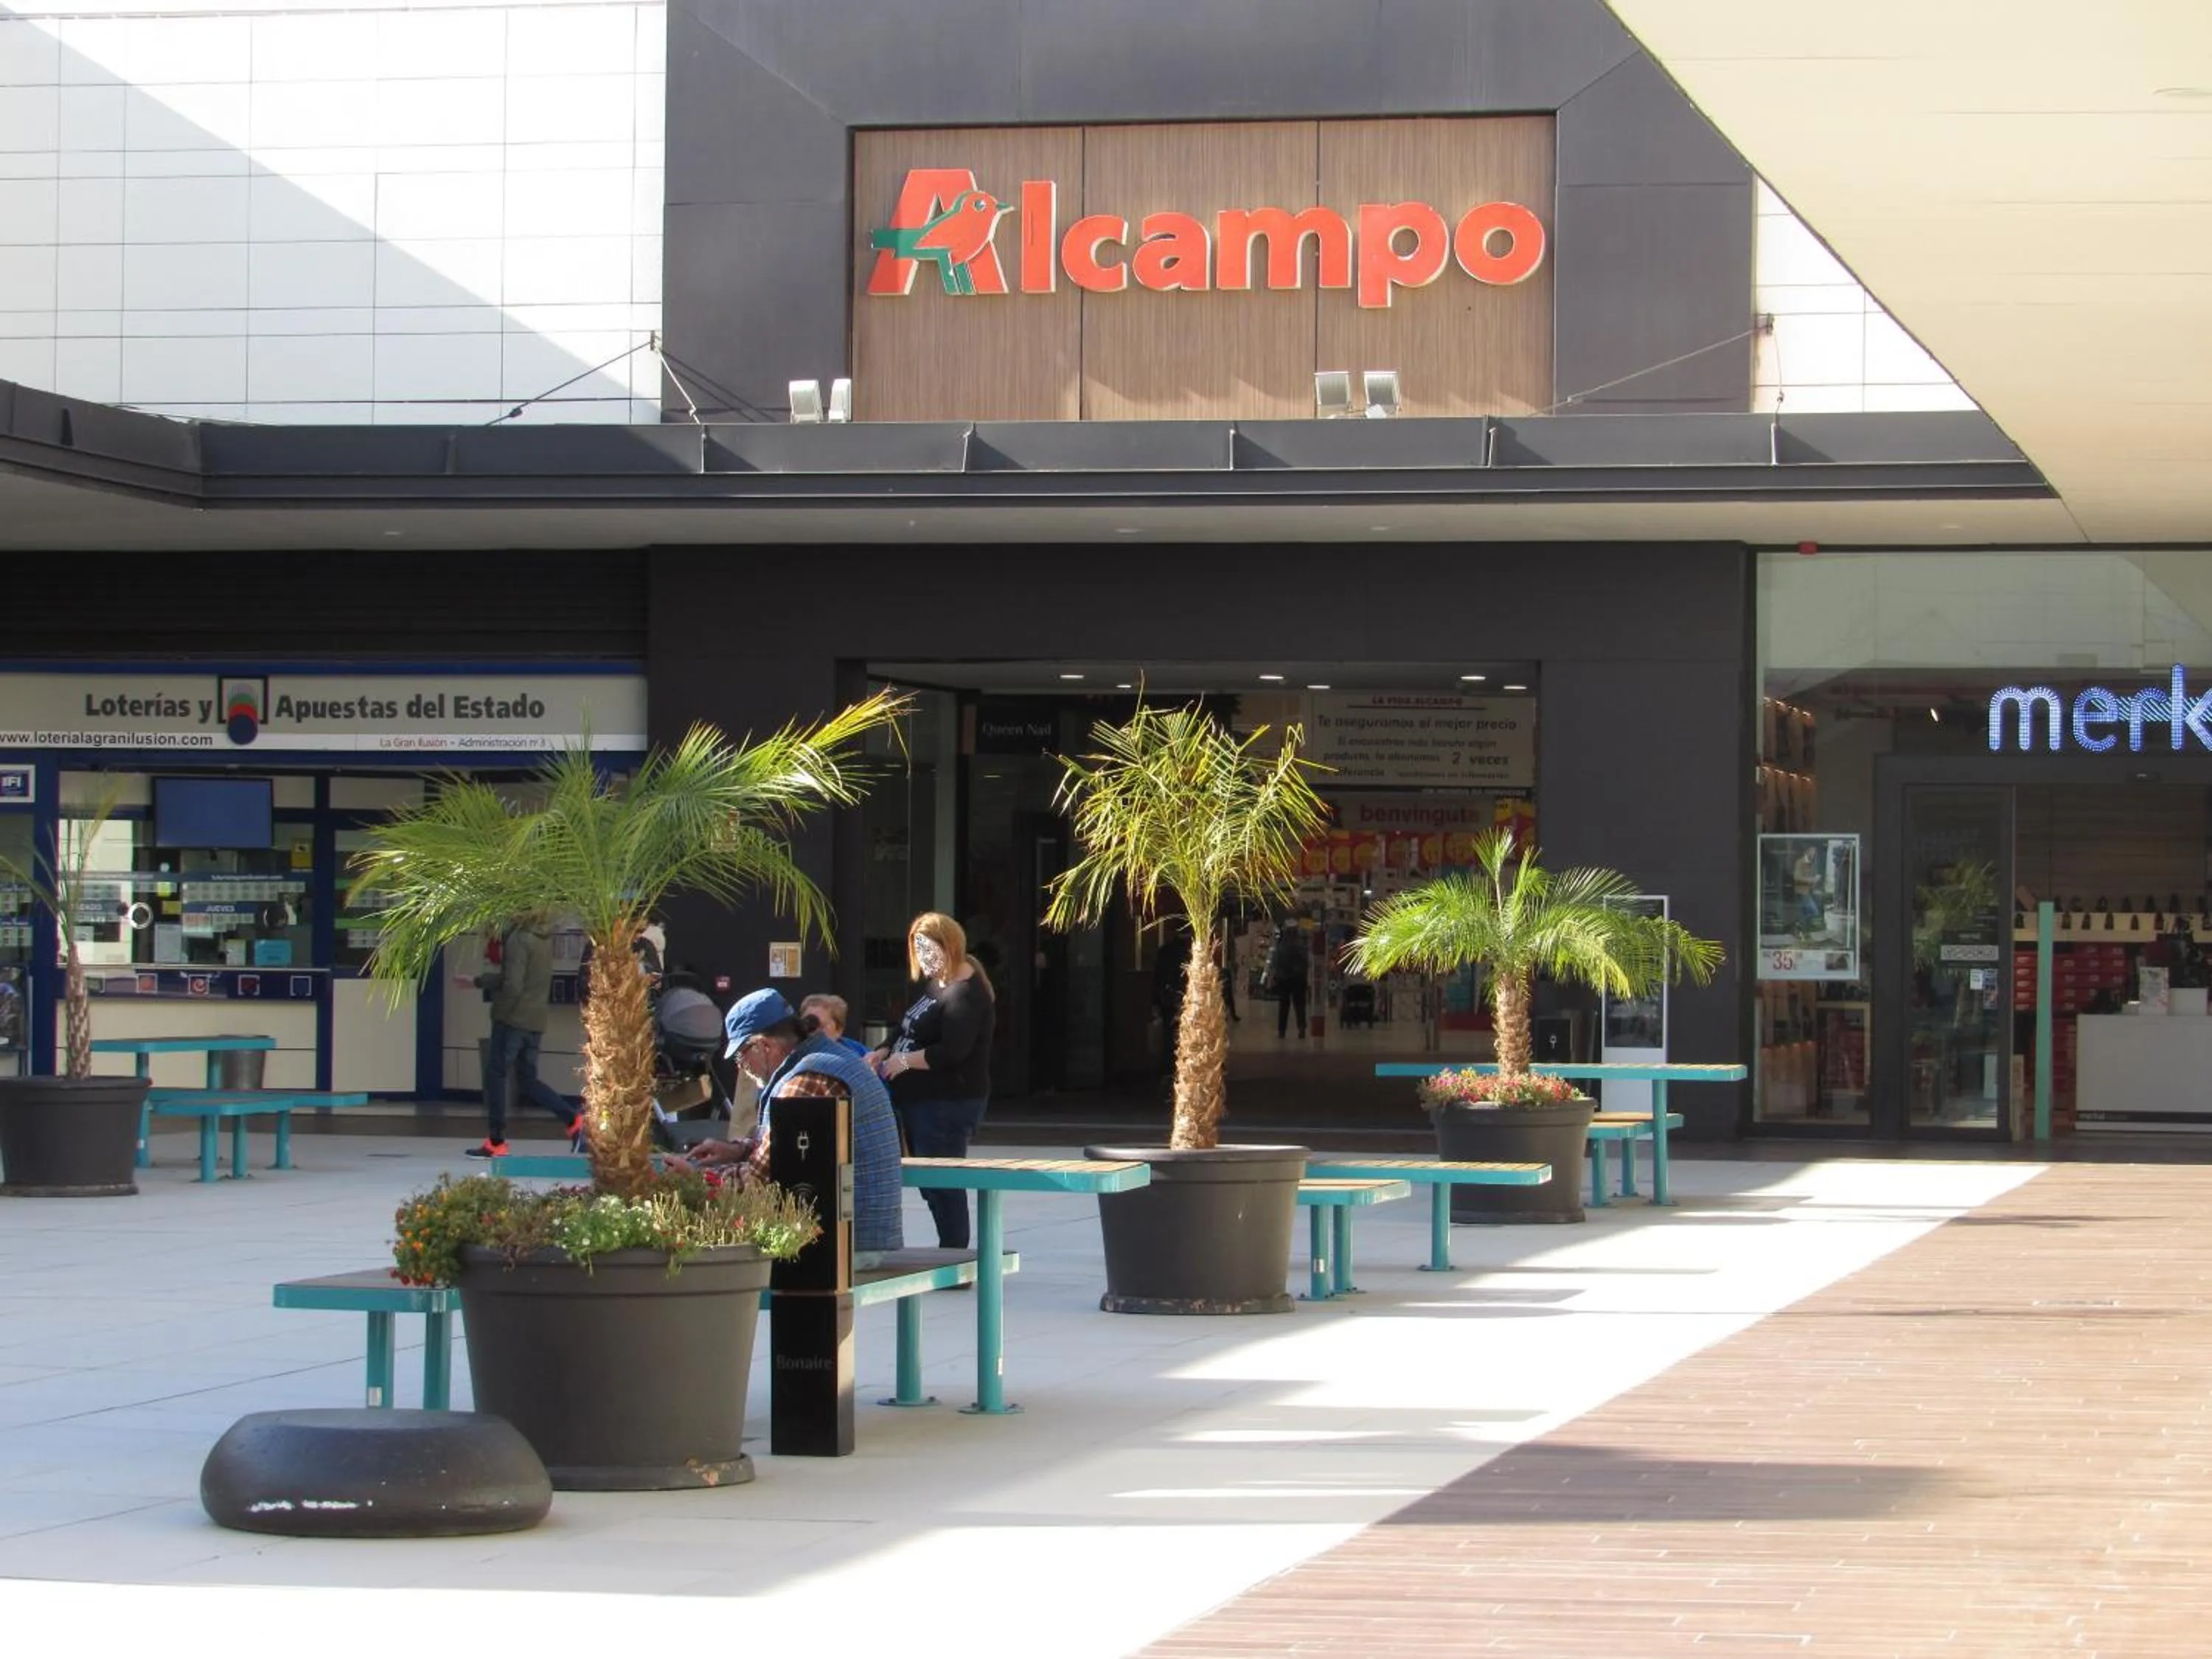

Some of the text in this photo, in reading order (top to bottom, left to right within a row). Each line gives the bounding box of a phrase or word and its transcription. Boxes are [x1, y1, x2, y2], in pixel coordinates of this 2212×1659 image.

[869, 167, 1548, 310] Alcampo
[86, 692, 546, 723] Loterías y Apuestas del Estado
[1989, 662, 2212, 752] merk
[1335, 716, 1414, 730] aseguramos
[1435, 717, 1472, 731] mejor
[1476, 718, 1517, 731] precio
[380, 738, 392, 747] La
[393, 737, 416, 747] Gran
[1451, 752, 1461, 765] 2
[1470, 754, 1509, 765] veces
[776, 1353, 835, 1370] Bonaire
